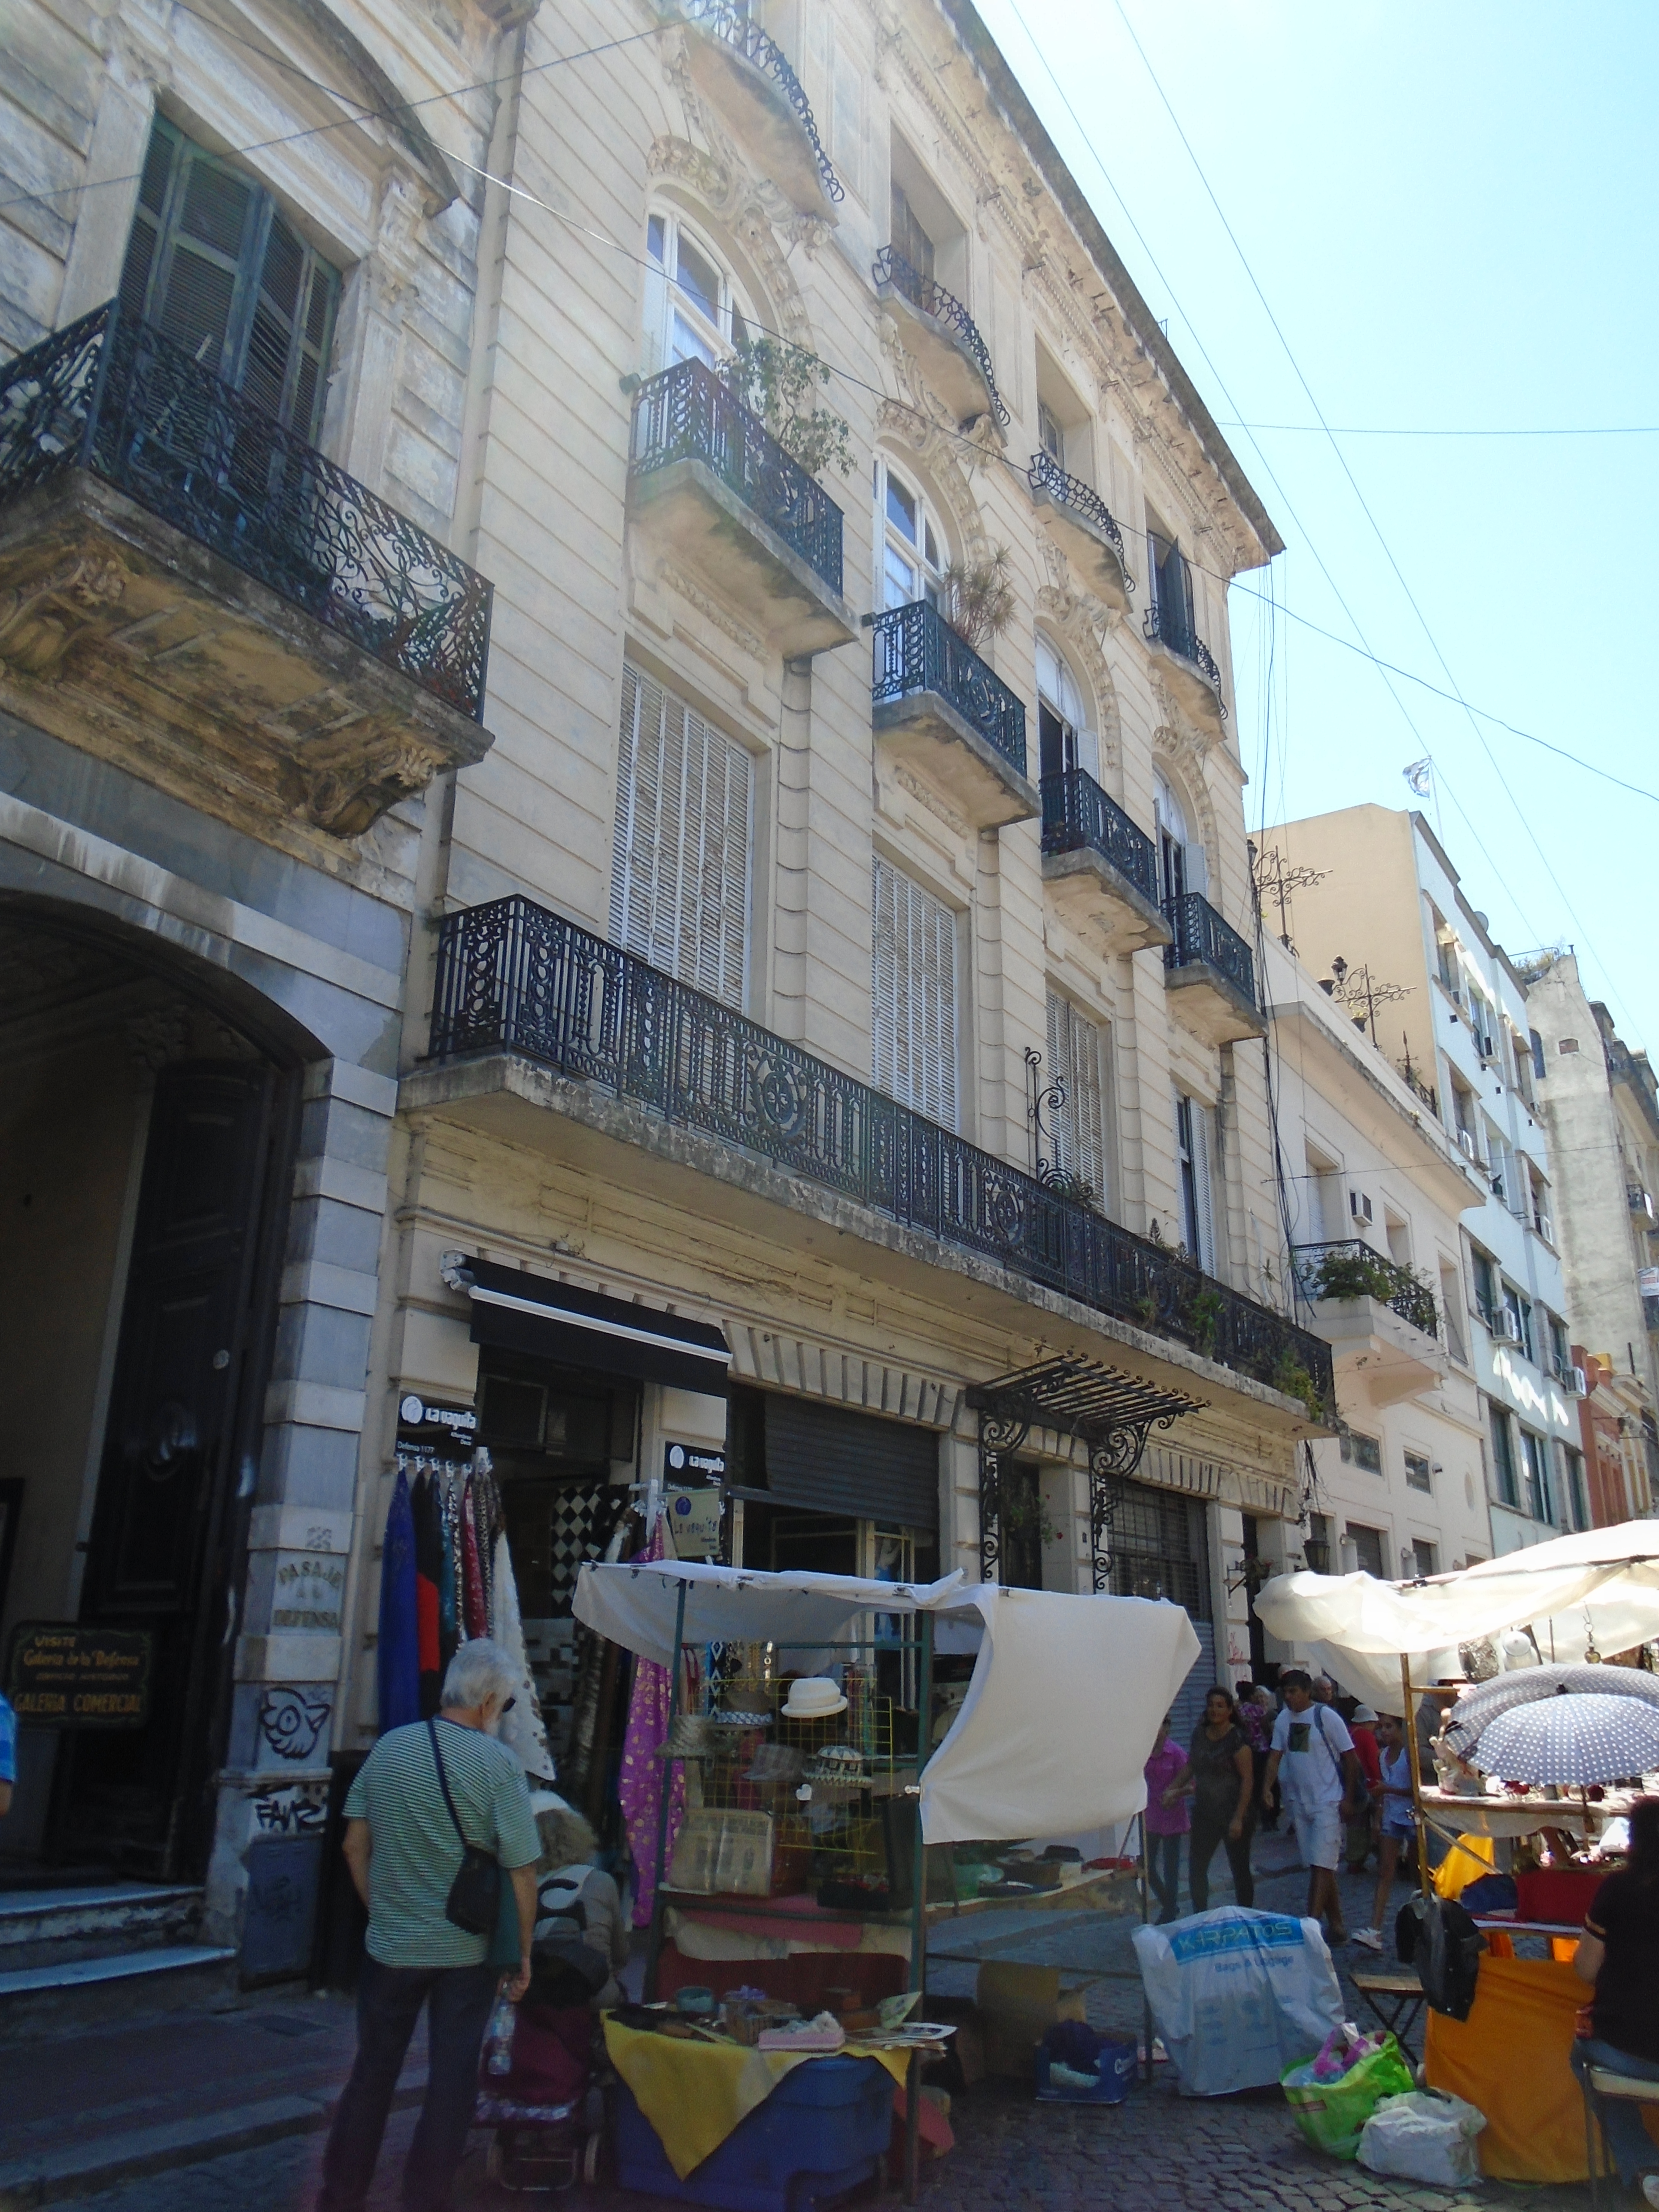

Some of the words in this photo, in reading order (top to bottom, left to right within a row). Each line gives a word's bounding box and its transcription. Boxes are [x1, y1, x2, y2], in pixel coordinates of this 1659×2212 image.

[425, 1407, 440, 1422] La
[689, 1455, 699, 1468] La
[278, 1561, 343, 1589] PASAJE
[273, 1609, 337, 1629] DEFENSA
[34, 1636, 76, 1647] VISITE
[74, 1693, 140, 1713] COMERCIAL
